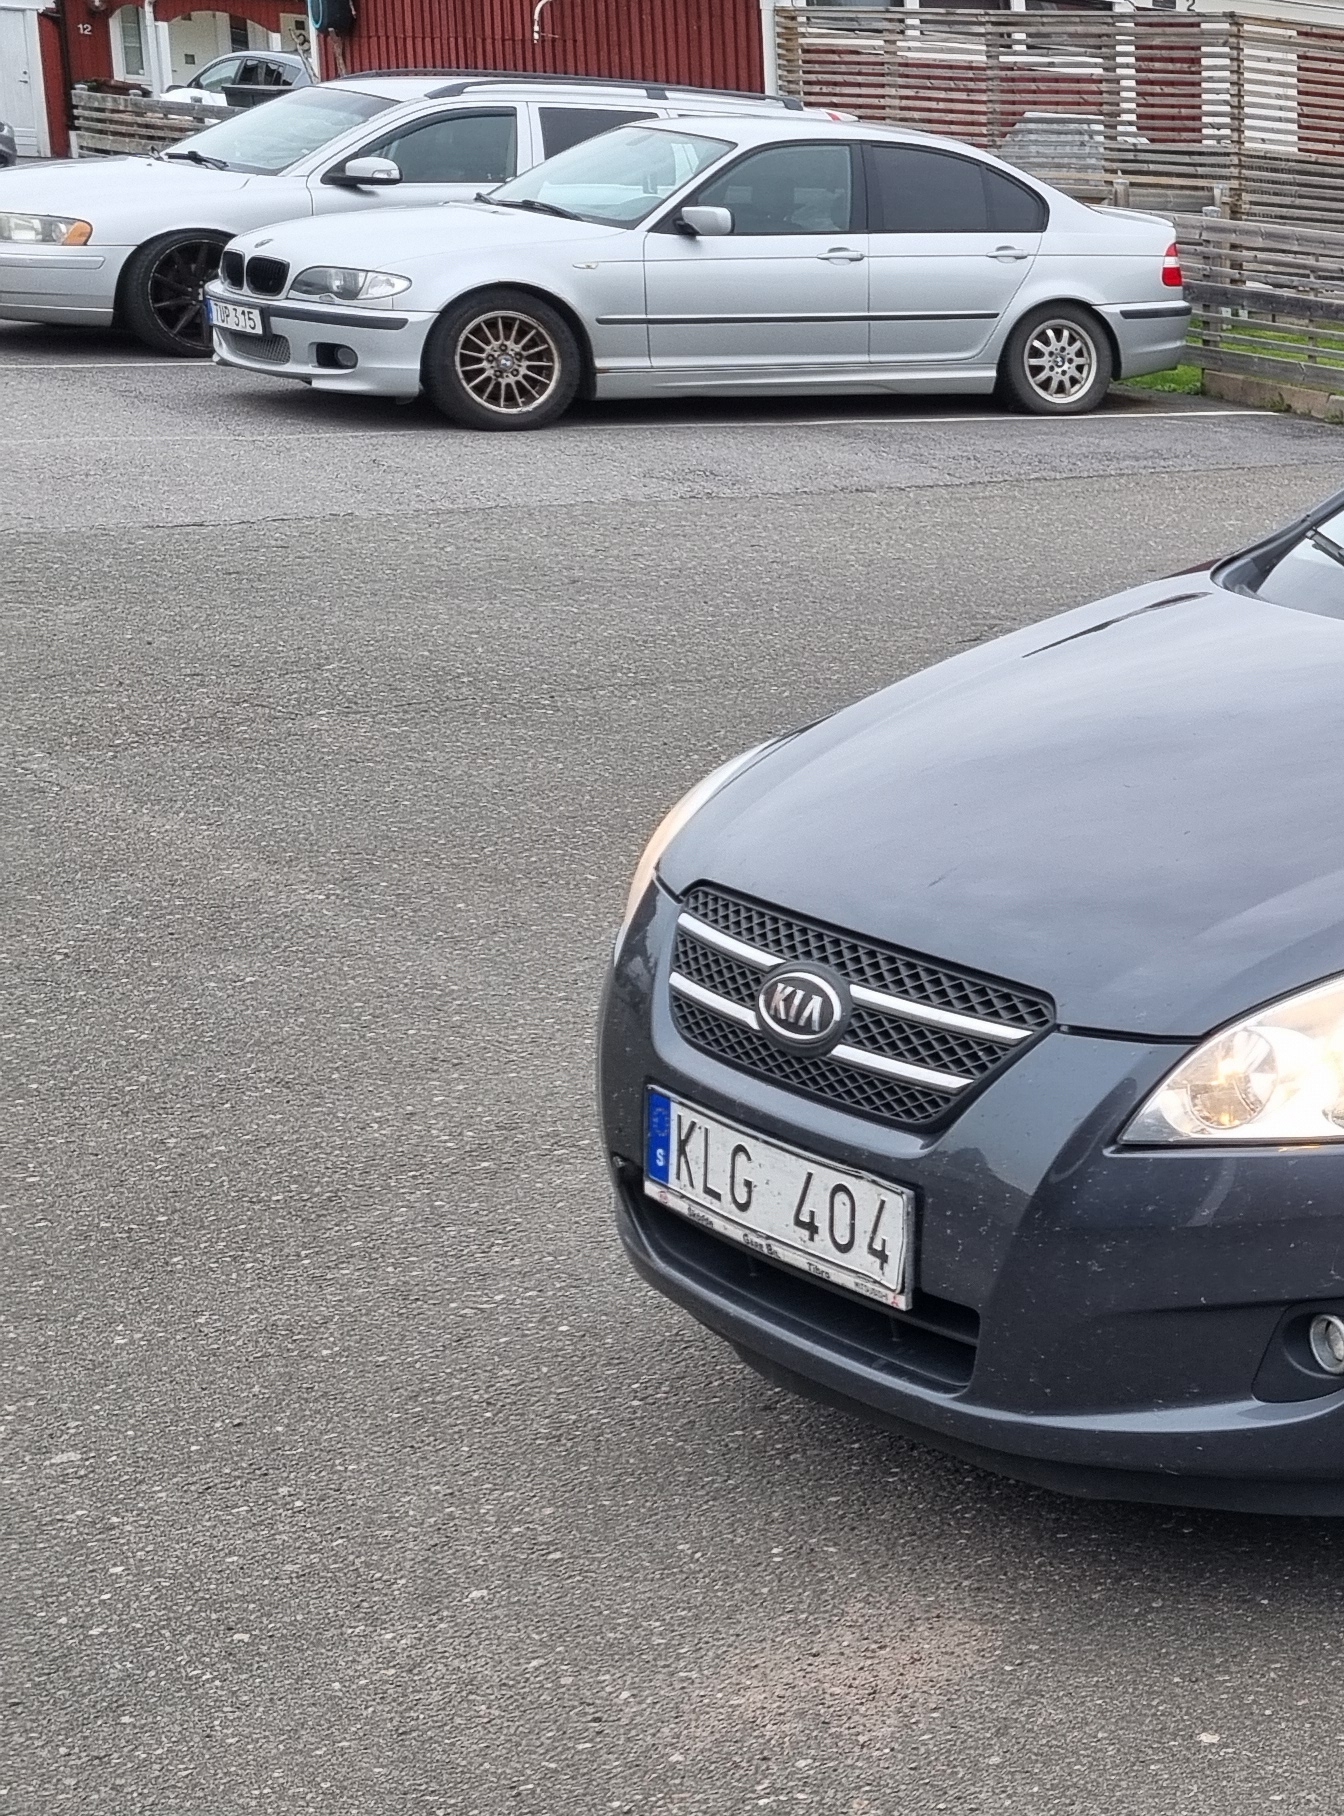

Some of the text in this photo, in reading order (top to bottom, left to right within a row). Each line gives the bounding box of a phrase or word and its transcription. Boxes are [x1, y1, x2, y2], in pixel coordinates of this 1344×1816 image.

[77, 23, 92, 35] 12
[214, 303, 256, 330] TUP 315
[770, 983, 823, 1032] KIA
[656, 1149, 665, 1166] S
[676, 1114, 889, 1275] KLG 404
